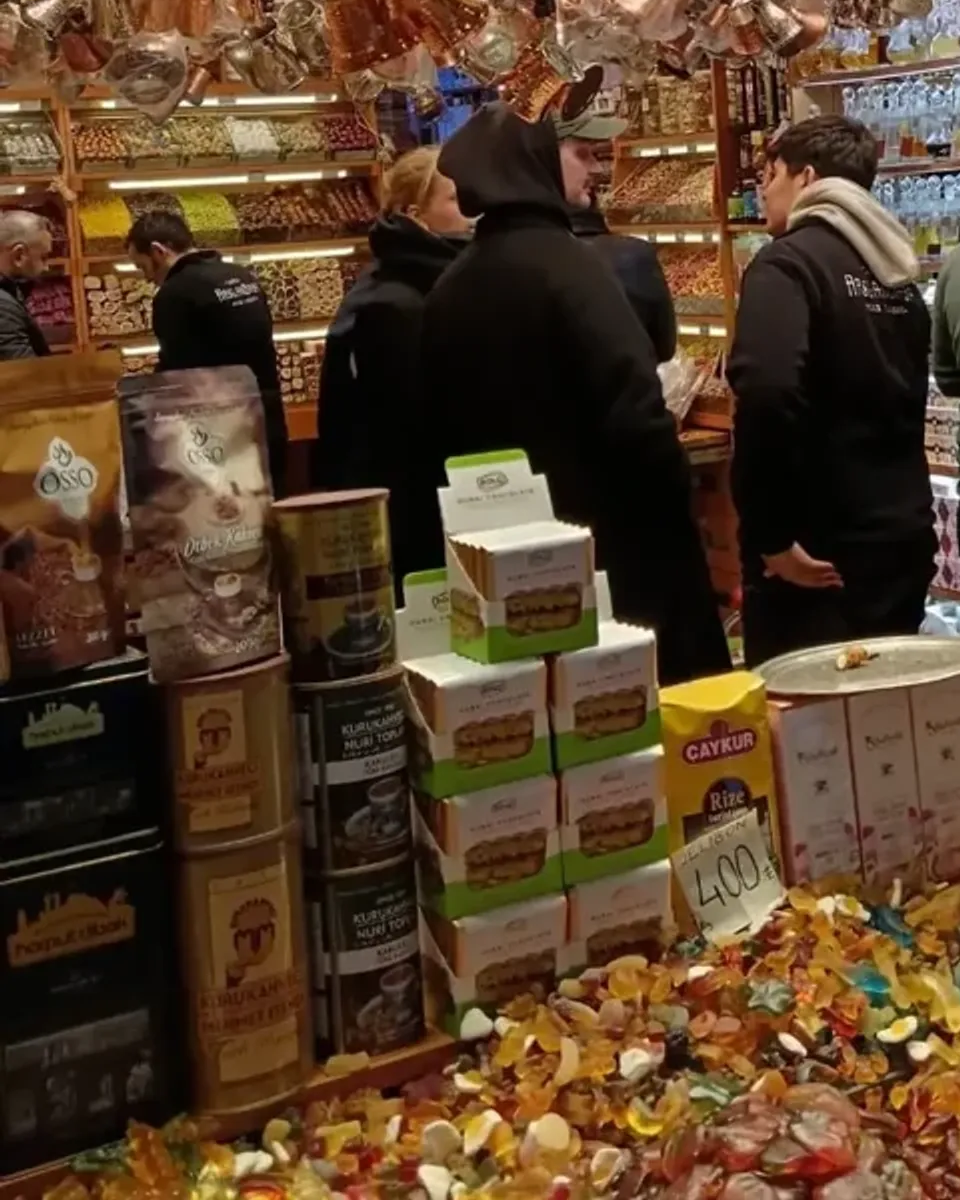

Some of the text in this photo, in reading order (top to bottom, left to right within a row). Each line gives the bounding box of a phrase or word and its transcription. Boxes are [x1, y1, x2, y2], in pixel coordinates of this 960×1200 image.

[40, 467, 93, 495] OSSO
[710, 790, 746, 811] Rize
[695, 844, 760, 907] 400
